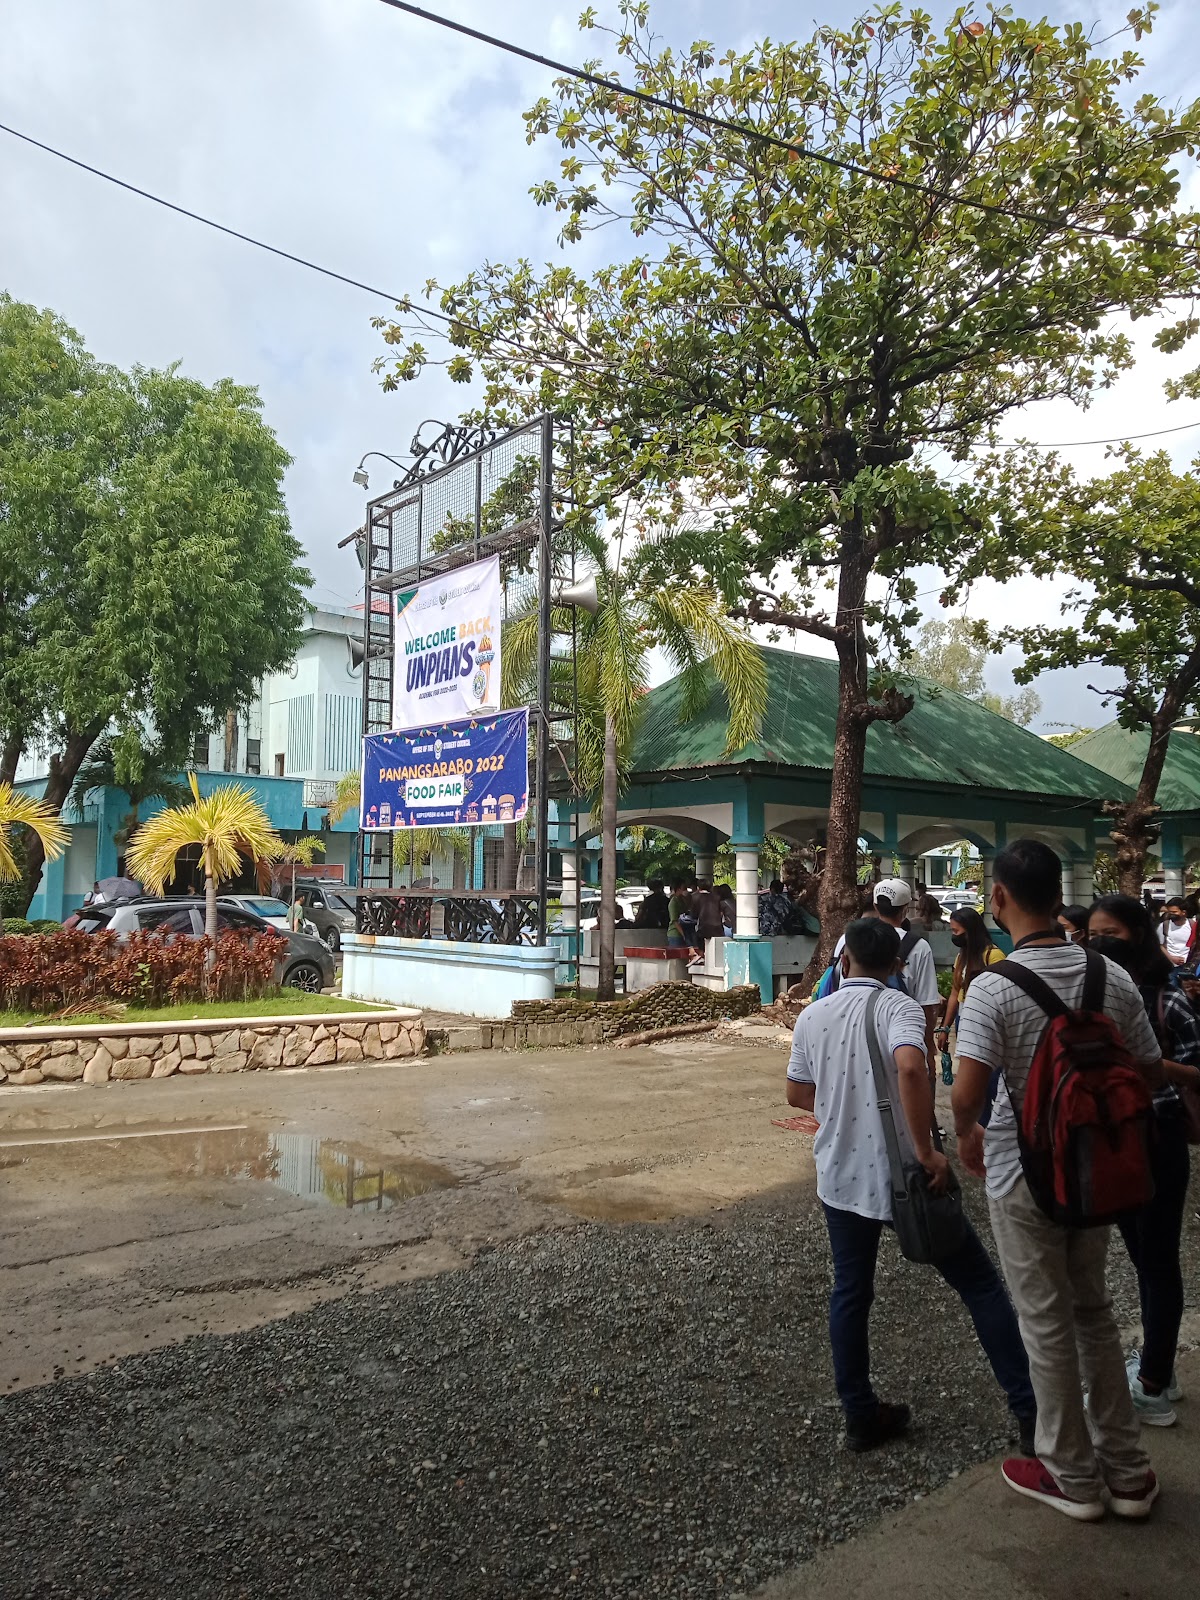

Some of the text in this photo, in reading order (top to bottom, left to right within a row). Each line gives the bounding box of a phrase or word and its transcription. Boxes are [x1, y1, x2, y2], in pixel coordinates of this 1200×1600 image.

[405, 626, 456, 655] WELCOME
[406, 641, 476, 693] UNPIANS
[379, 754, 505, 783] PANANGSARABO 2022
[407, 782, 462, 800] FOOD FAIR
[876, 886, 896, 899] RAIDERS
